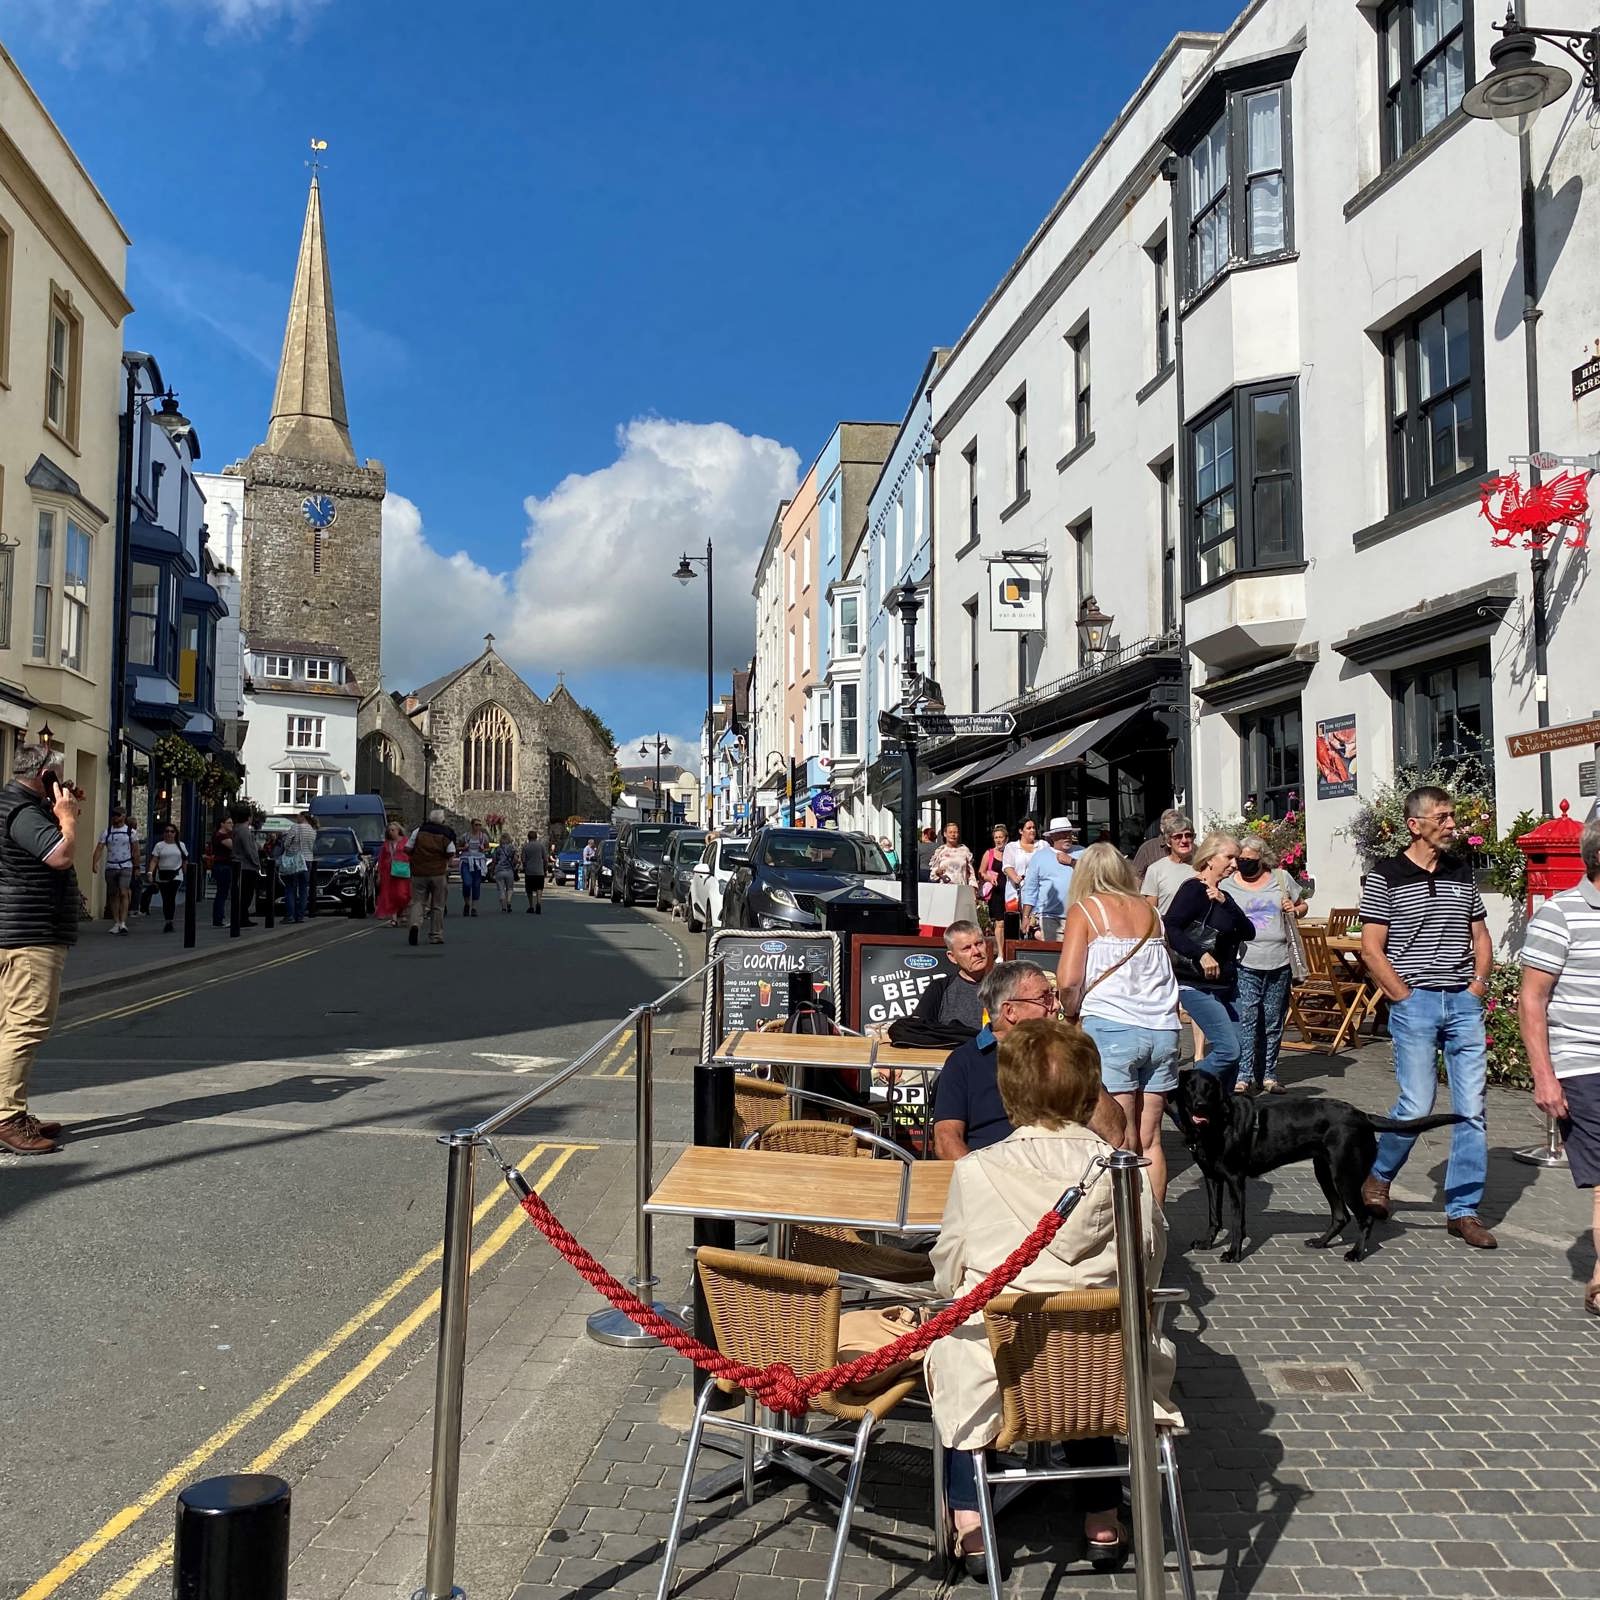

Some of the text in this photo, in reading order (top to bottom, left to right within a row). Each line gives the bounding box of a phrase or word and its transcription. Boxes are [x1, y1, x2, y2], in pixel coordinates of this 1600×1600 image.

[1574, 374, 1600, 395] STRE
[1532, 453, 1558, 469] Wales
[1585, 722, 1600, 732] Tud
[1525, 743, 1548, 751] Tudor
[743, 954, 806, 972] COCKTAILS
[870, 969, 911, 984] Family
[882, 973, 947, 1001] BEE
[868, 998, 920, 1022] GAR
[886, 1088, 921, 1103] OP
[893, 1116, 914, 1125] TED
